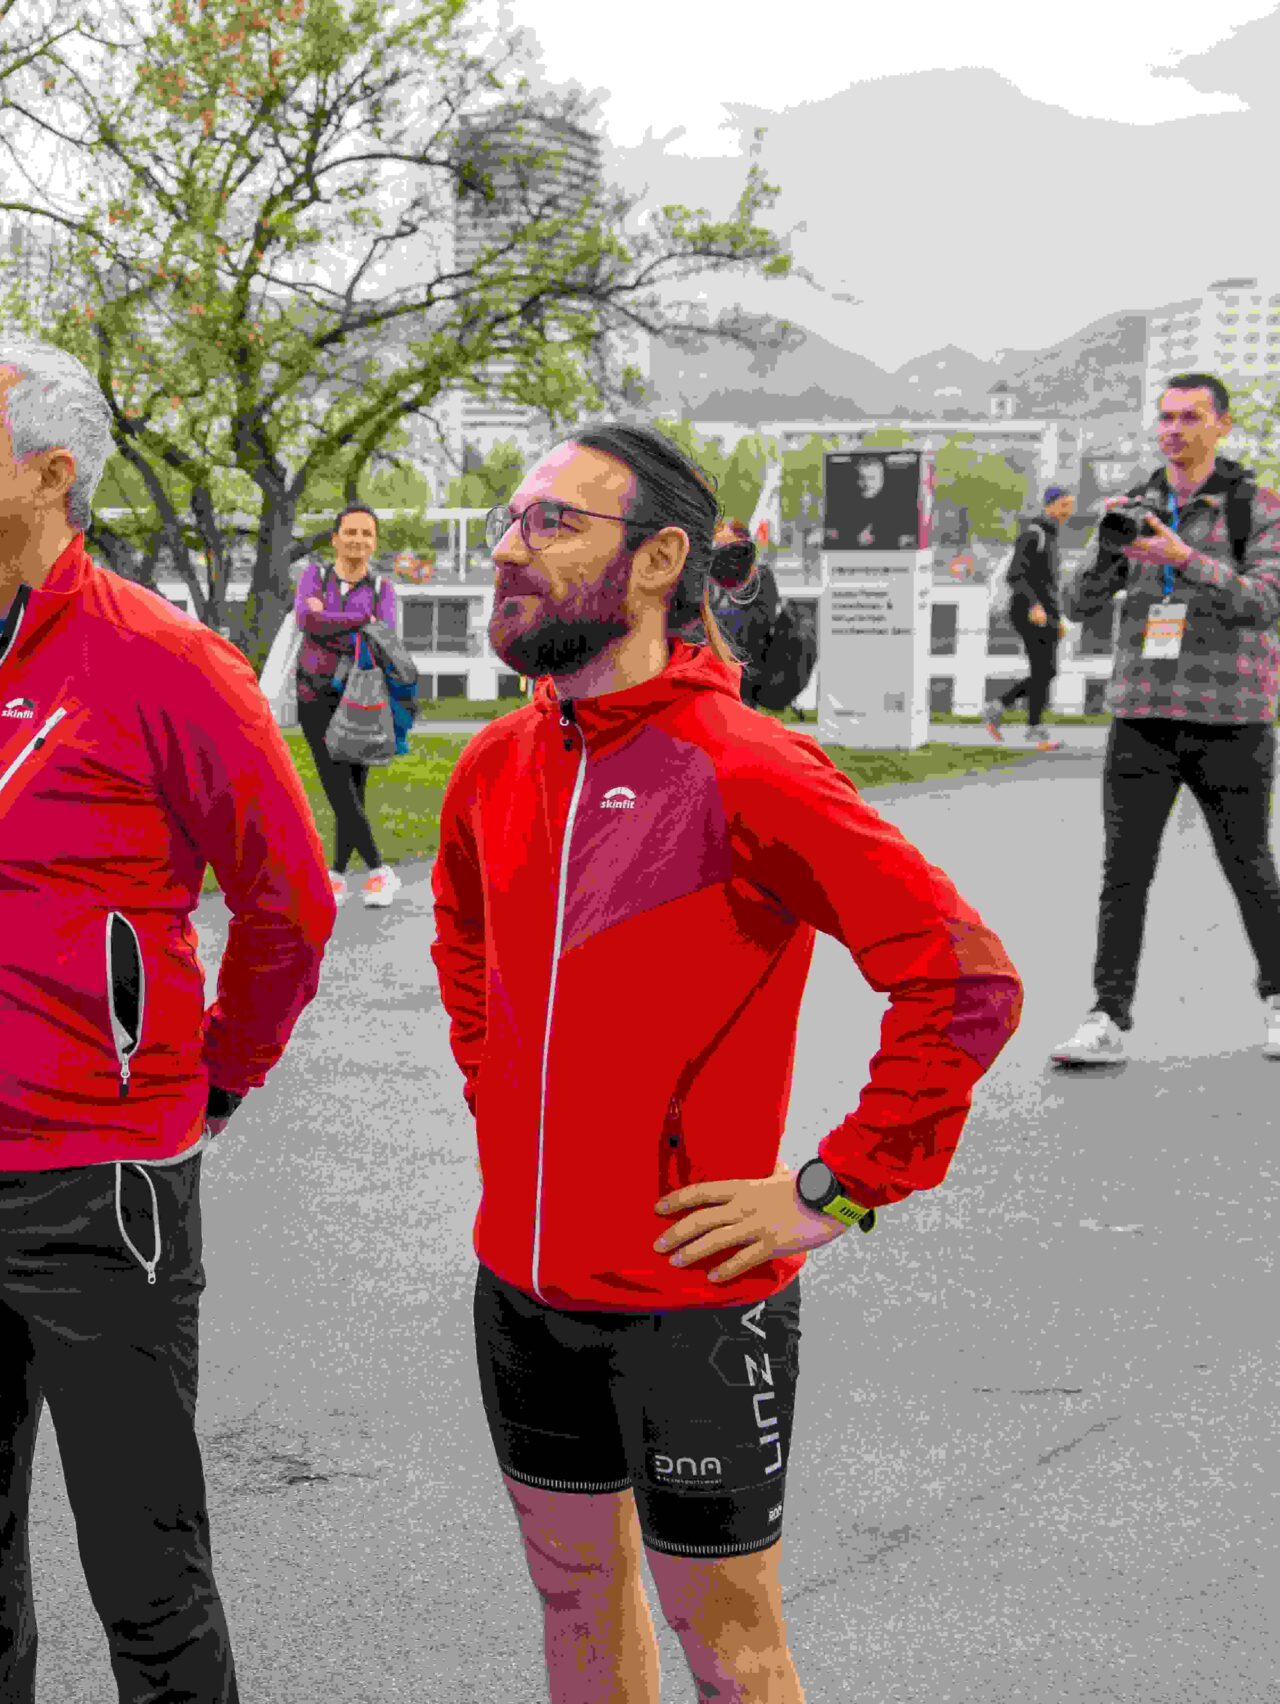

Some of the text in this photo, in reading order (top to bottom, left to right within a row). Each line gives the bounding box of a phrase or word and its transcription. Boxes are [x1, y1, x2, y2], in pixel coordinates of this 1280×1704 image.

[1, 708, 35, 720] skinfit
[600, 799, 635, 809] skinfit
[654, 1454, 722, 1477] DNA
